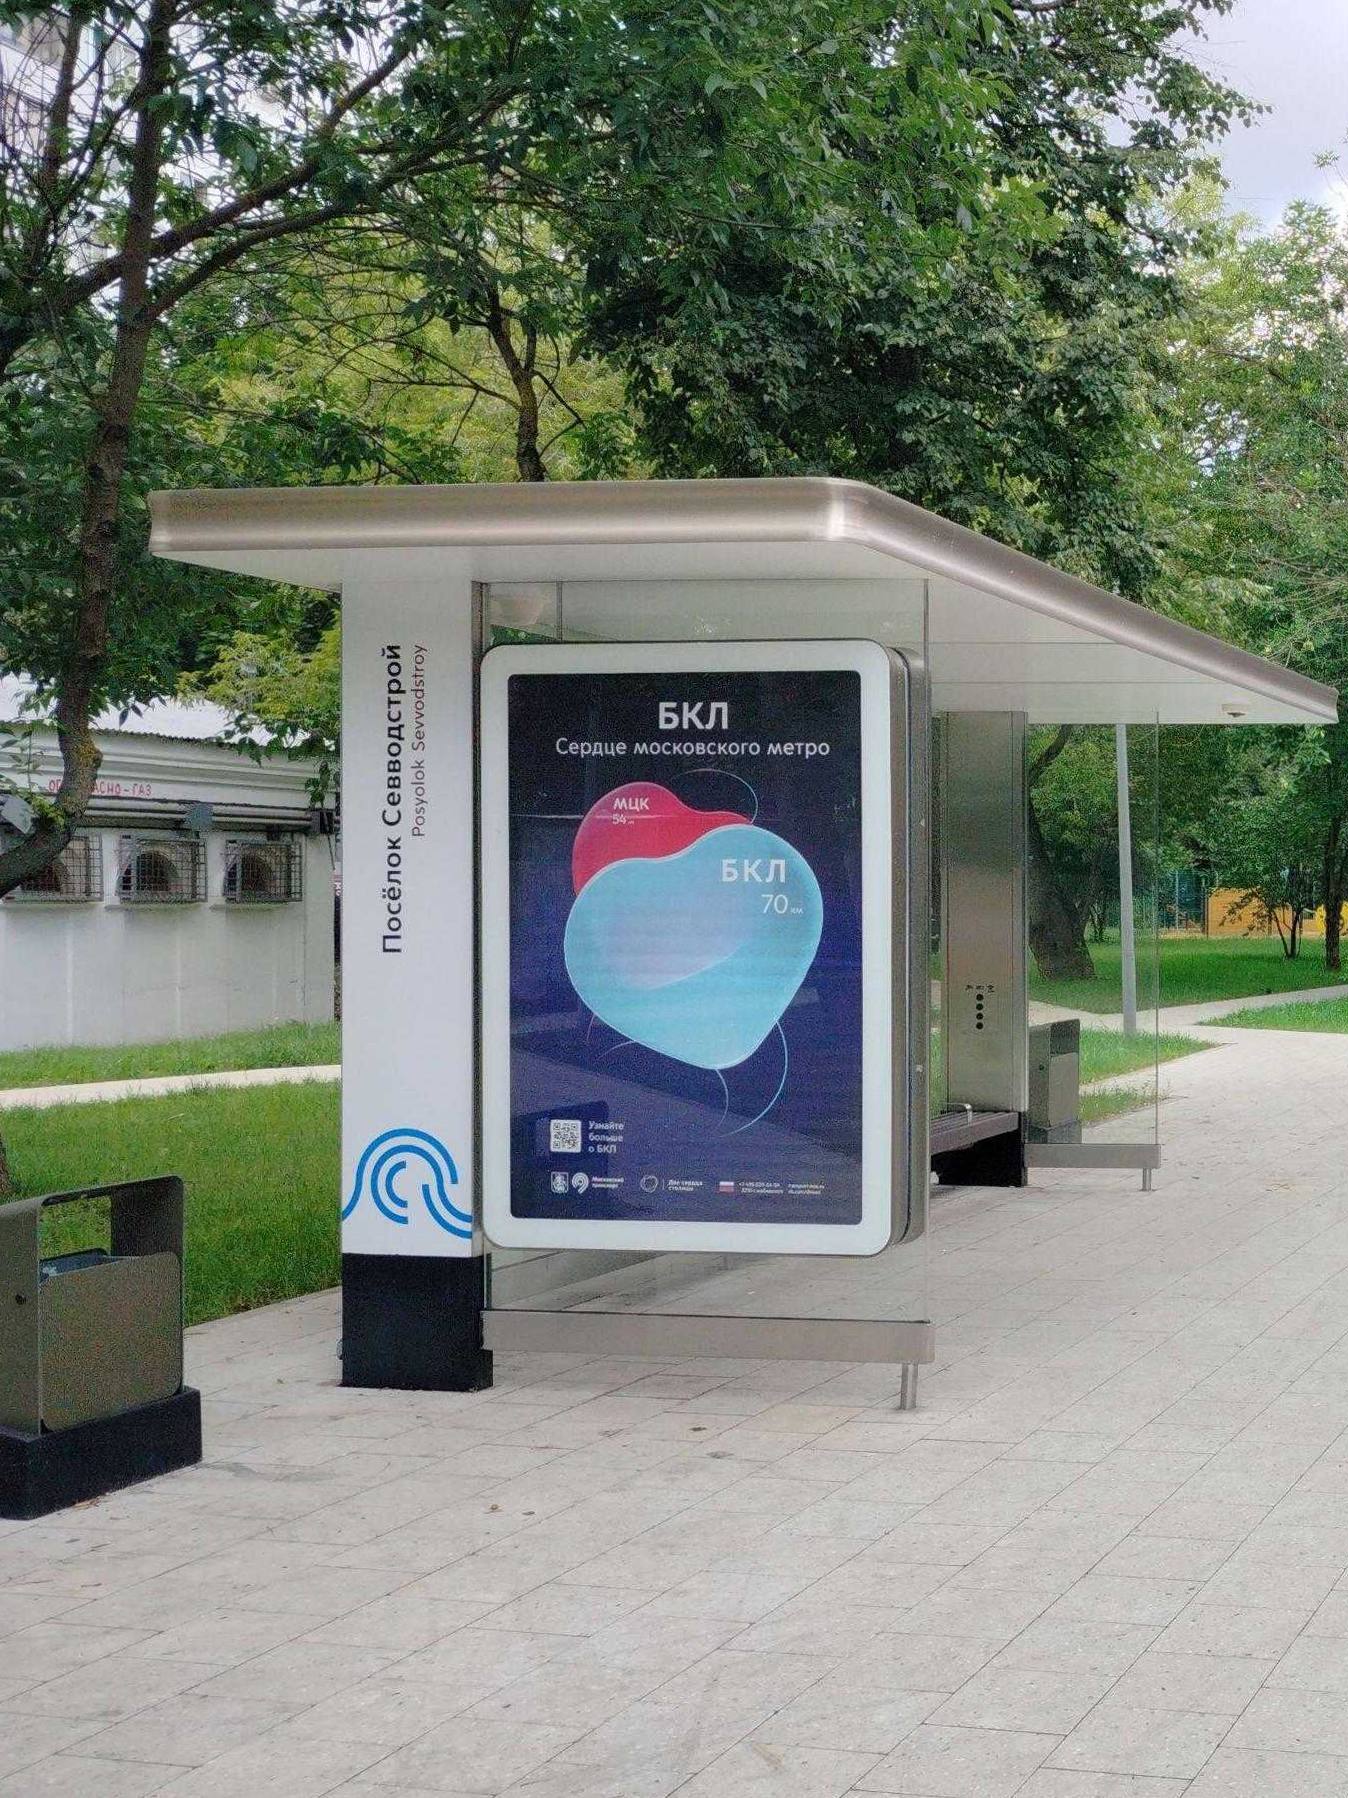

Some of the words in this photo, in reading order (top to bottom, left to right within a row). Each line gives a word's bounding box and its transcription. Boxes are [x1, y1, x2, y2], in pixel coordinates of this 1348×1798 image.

[411, 645, 428, 751] Sevvodstroy
[658, 702, 729, 730] БКЛ
[381, 645, 407, 826] Севводстрой
[555, 738, 628, 758] Сердце
[633, 741, 761, 756] московского
[766, 742, 831, 759] метро
[411, 760, 428, 837] Posyolok
[613, 797, 650, 812] МЦК
[612, 813, 627, 825] 54
[722, 859, 786, 883] БКЛ
[382, 837, 402, 953] Посёлок
[761, 894, 789, 914] 70
[597, 1144, 617, 1153] БКЛ
